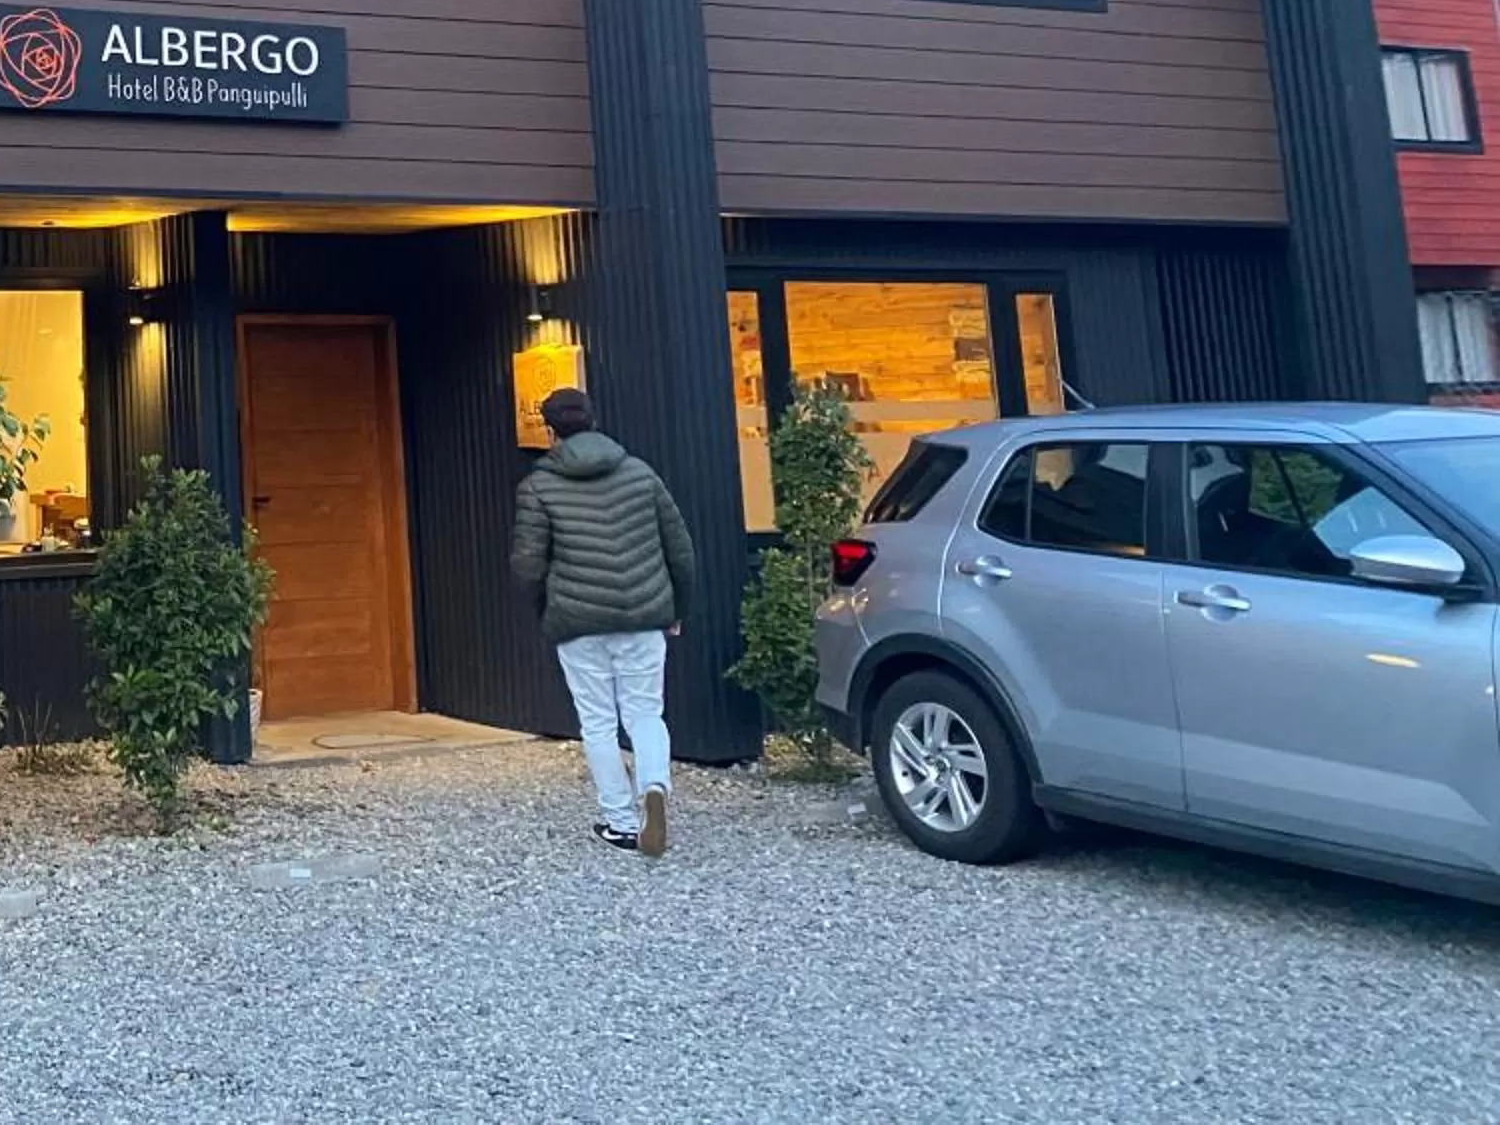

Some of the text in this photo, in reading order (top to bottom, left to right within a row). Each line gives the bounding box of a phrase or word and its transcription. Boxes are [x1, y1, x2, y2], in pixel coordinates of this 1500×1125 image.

[101, 24, 319, 76] ALBERGO
[108, 72, 308, 111] Hotel B&B Panguipulli
